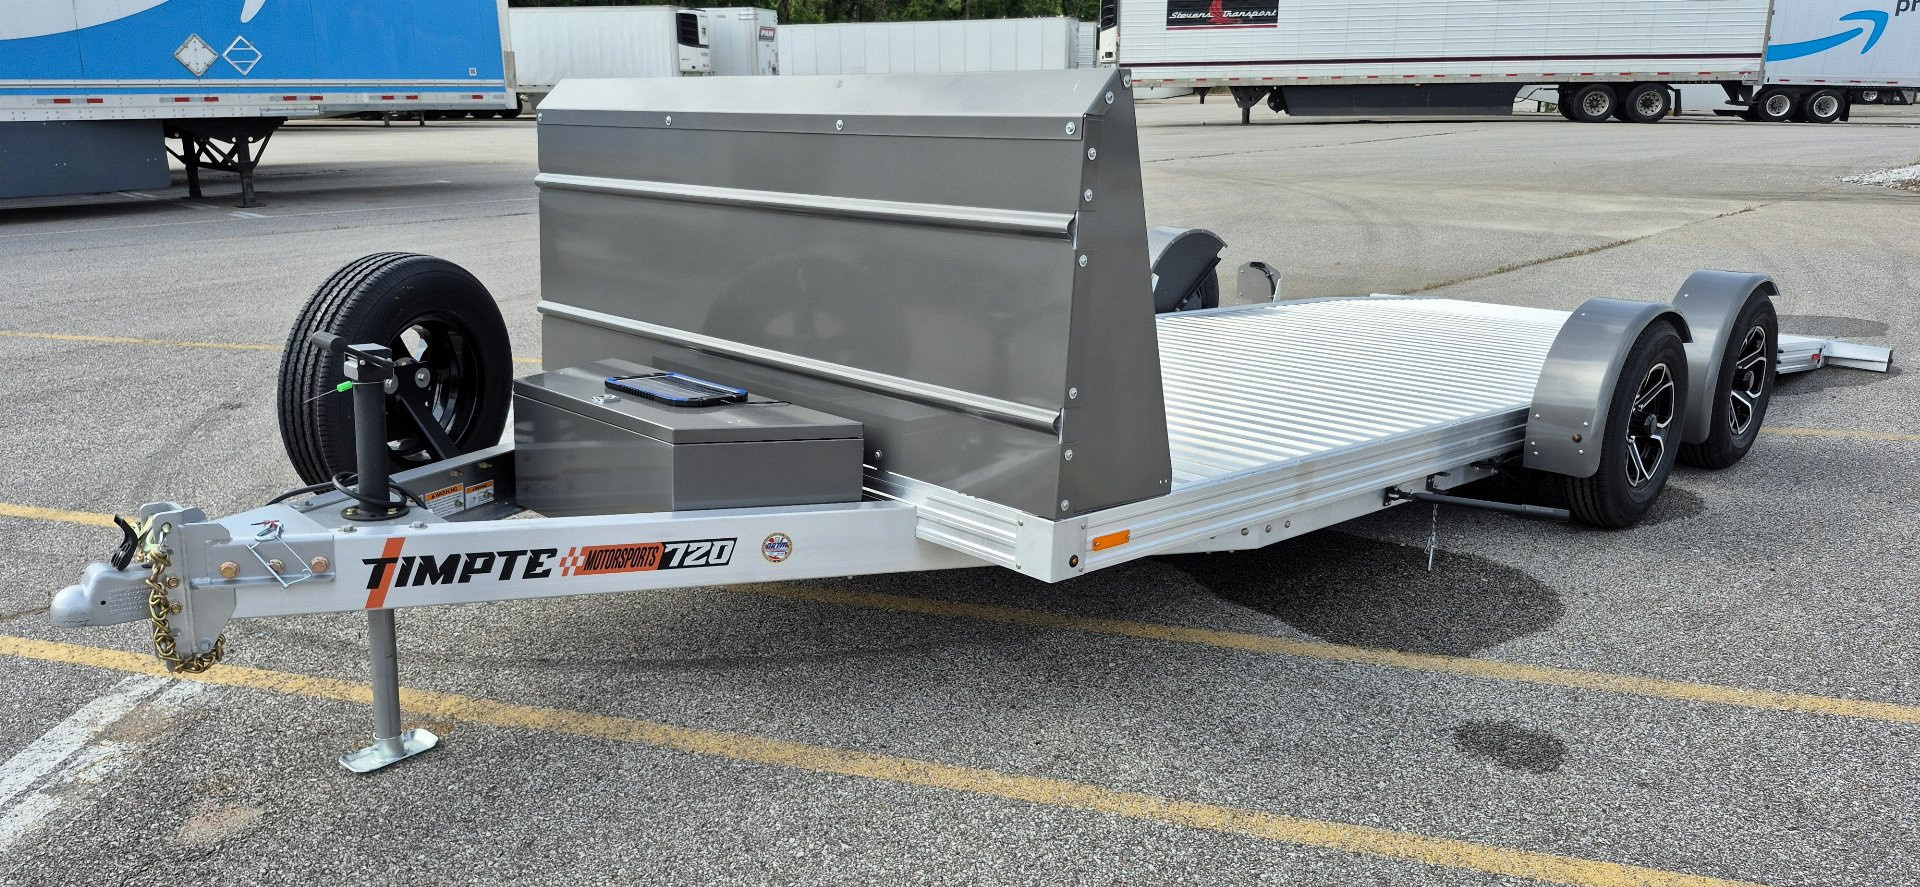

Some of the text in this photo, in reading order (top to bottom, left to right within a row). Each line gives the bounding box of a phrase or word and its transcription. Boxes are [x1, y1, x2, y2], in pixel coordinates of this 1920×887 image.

[1169, 9, 1277, 19] Stevens Transport
[760, 29, 774, 37] PAM
[435, 486, 458, 498] WARNING
[361, 540, 735, 606] TIMPTE MOTORSPORTS 720
